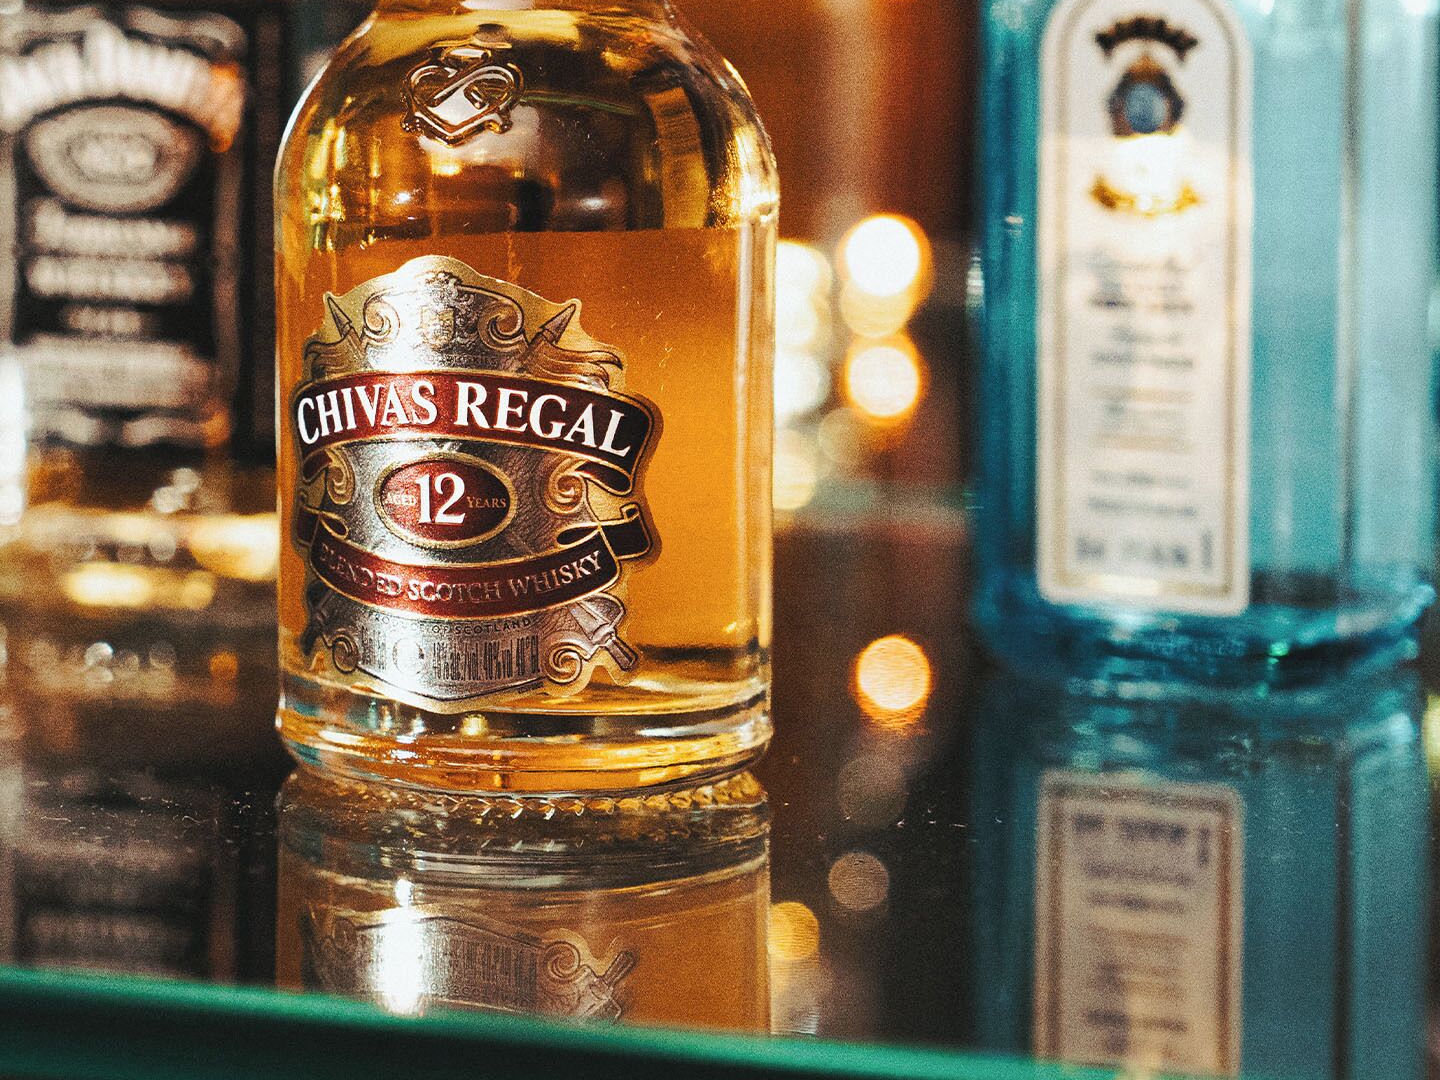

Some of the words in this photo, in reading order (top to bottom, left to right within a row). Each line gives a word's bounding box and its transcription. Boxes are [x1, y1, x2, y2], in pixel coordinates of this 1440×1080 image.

[297, 380, 438, 445] CHIVAS
[453, 380, 632, 458] REGAL
[385, 490, 418, 507] AGED
[415, 472, 466, 525] 12
[466, 495, 508, 509] YEARS
[321, 542, 403, 597] BLENDED
[408, 579, 502, 603] SCOTCH
[509, 550, 602, 597] WHISKY
[431, 624, 451, 634] OF
[455, 619, 532, 635] SCOTLAND
